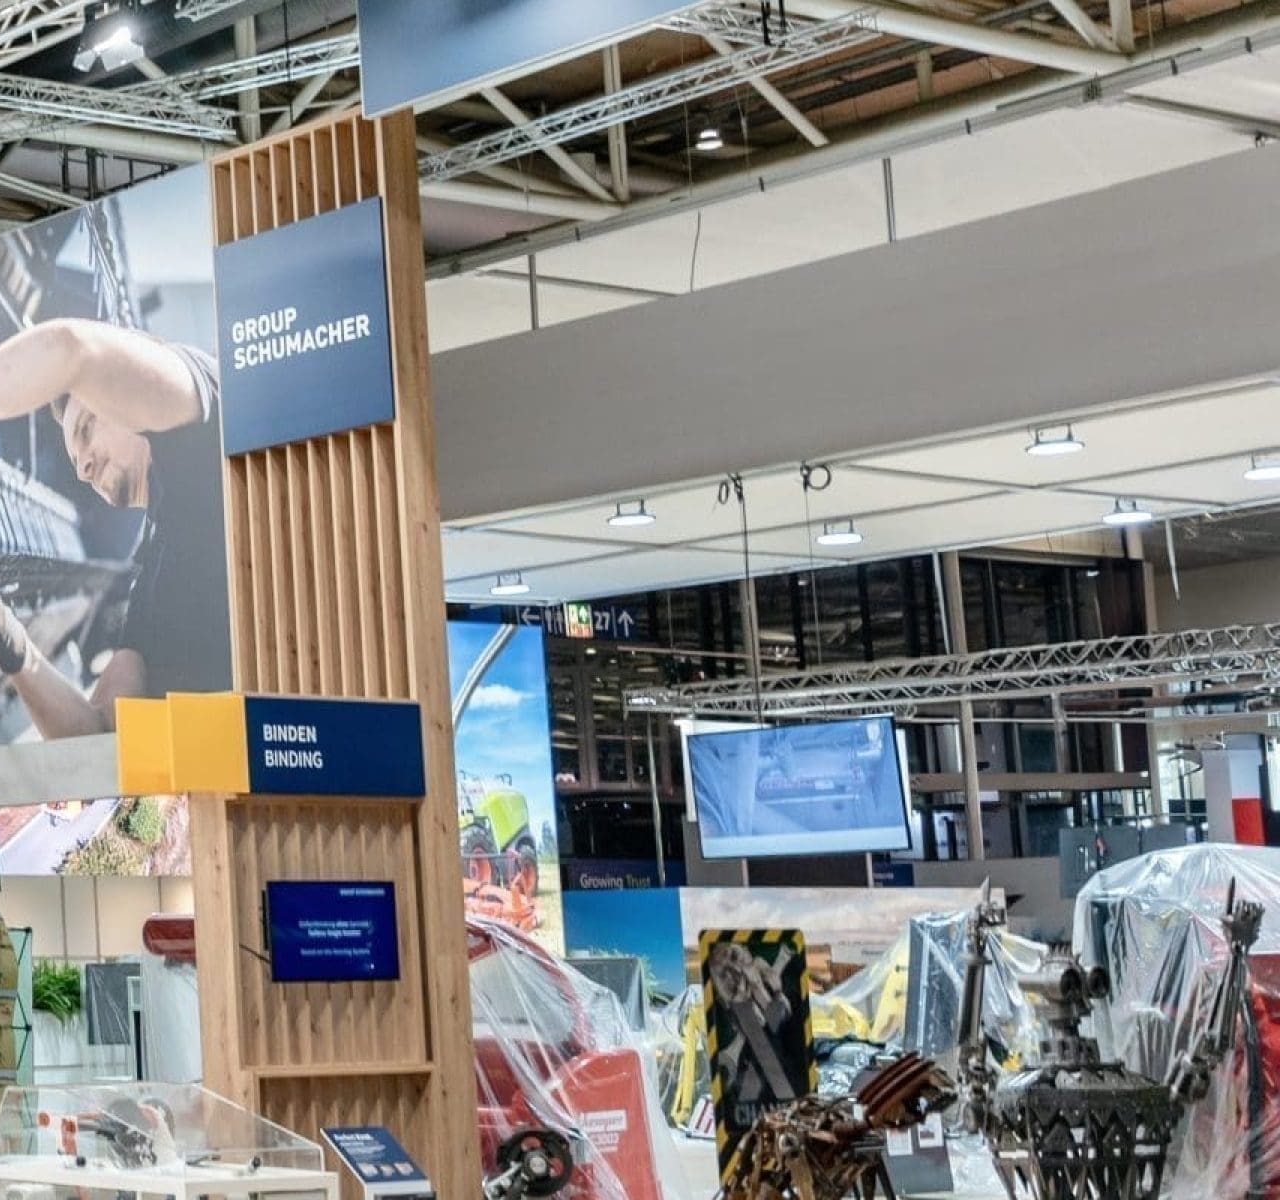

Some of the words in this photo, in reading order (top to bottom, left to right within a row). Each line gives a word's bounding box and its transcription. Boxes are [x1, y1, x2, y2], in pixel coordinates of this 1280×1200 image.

[232, 307, 297, 344] GROUP
[234, 314, 371, 370] SCHUMACHER
[593, 611, 610, 631] 27
[263, 724, 318, 744] BINDEN
[265, 749, 324, 769] BINDING
[580, 873, 623, 891] Growing
